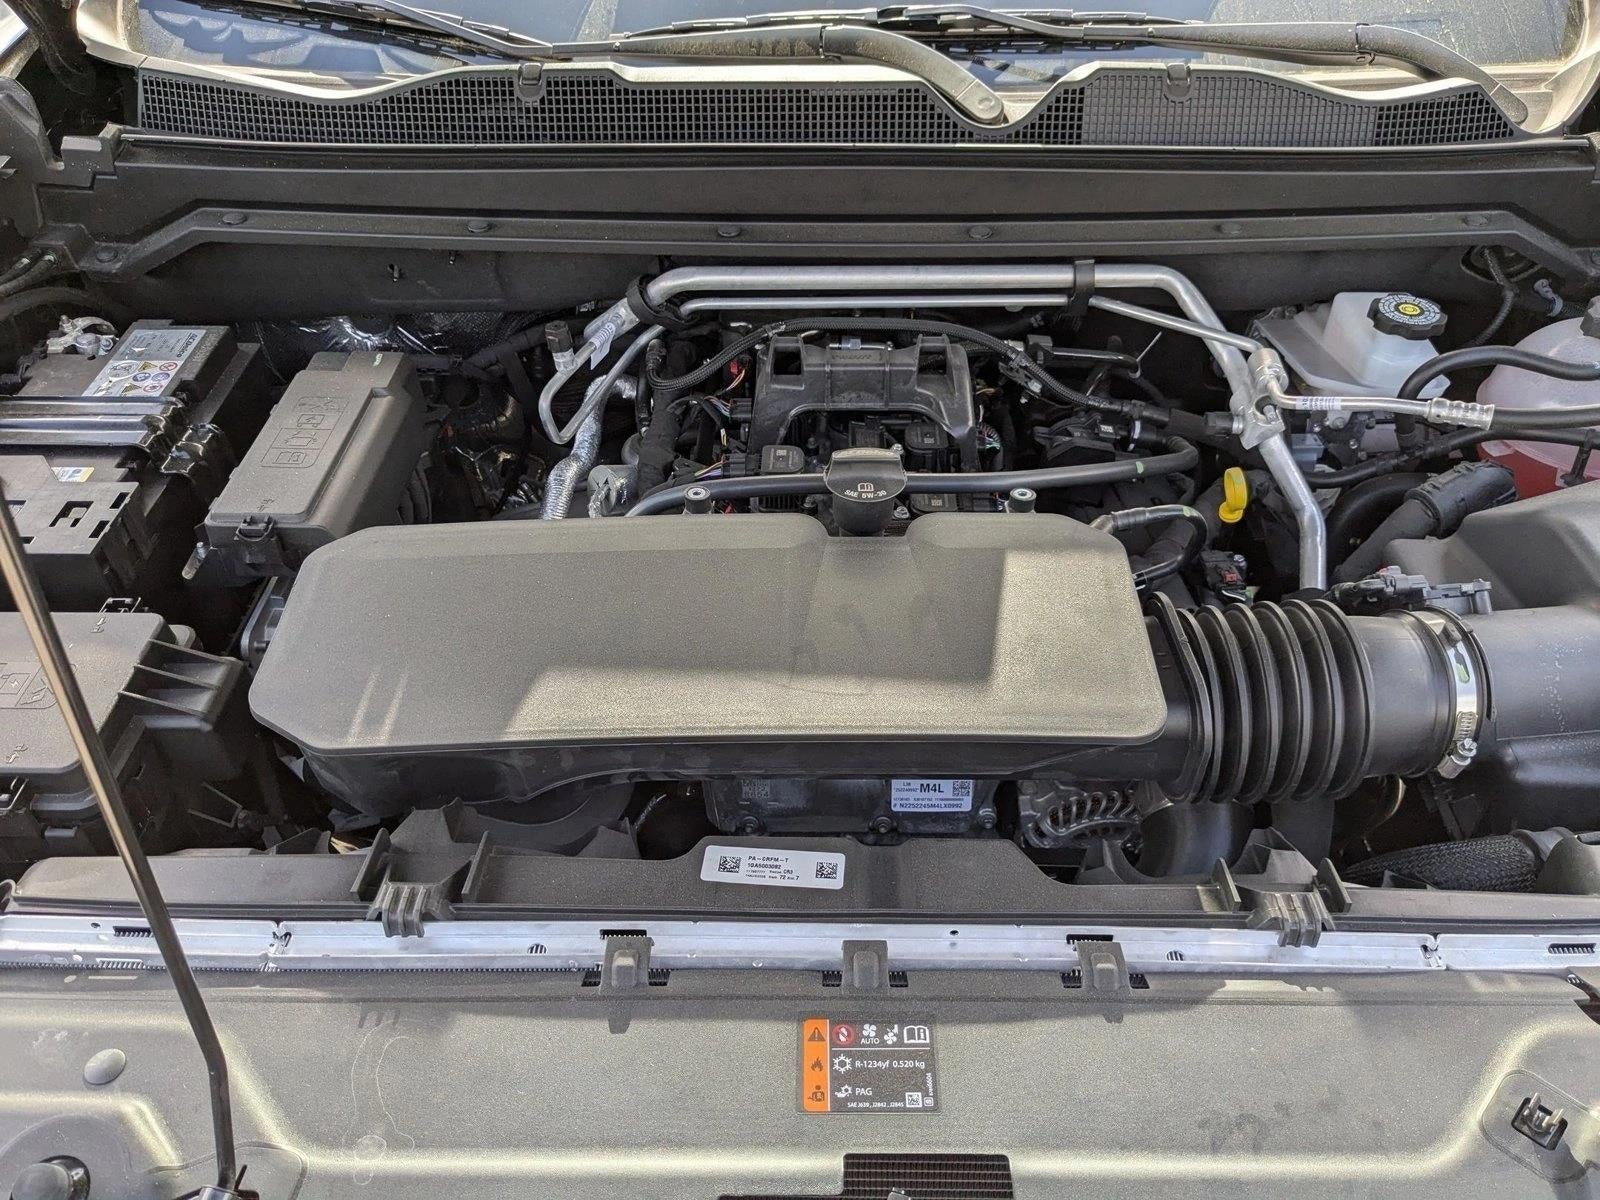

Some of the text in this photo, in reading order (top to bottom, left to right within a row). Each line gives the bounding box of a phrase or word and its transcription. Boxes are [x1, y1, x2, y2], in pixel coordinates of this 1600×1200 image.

[844, 489, 859, 498] SAE
[919, 783, 945, 793] M4L
[860, 1037, 880, 1045] AUTO
[855, 1060, 925, 1070] R-1234yf 0.520 kg
[855, 1087, 873, 1096] PAG
